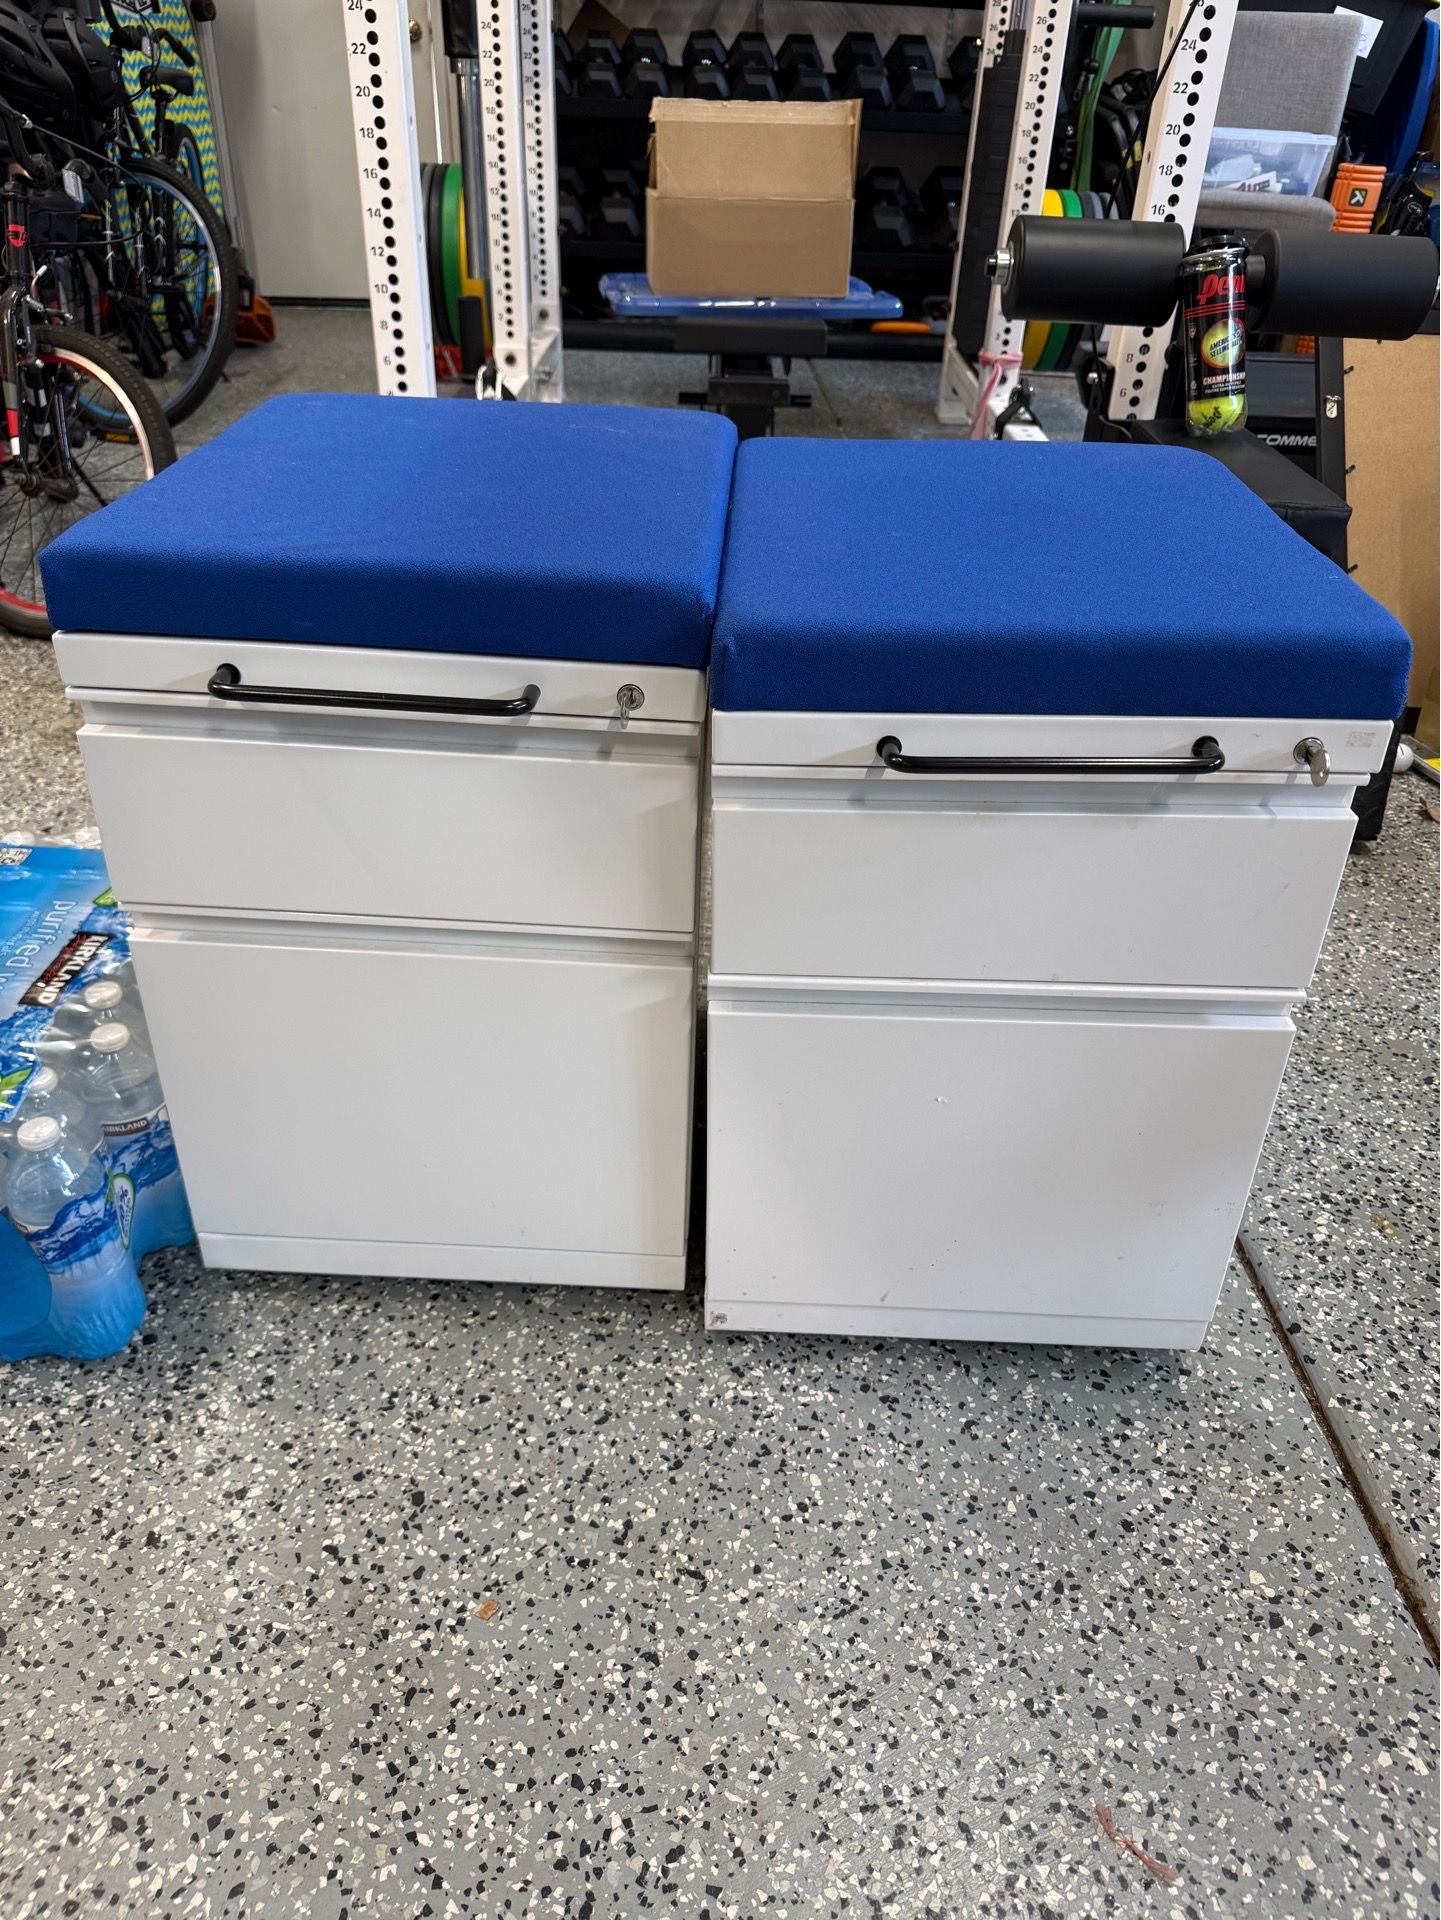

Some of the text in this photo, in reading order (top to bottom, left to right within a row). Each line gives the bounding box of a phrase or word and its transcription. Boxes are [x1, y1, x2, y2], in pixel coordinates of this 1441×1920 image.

[347, 0, 363, 10] 24
[481, 21, 491, 29] 24
[1036, 16, 1047, 25] 26
[351, 42, 367, 54] 22
[1032, 45, 1043, 53] 24
[1181, 39, 1197, 51] 24
[482, 50, 493, 58] 22
[484, 78, 495, 87] 20
[1028, 73, 1040, 82] 22
[355, 85, 371, 97] 20
[1173, 82, 1189, 94] 22
[1024, 102, 1036, 110] 20
[359, 127, 375, 139] 18
[1165, 124, 1181, 135] 20
[1018, 156, 1028, 164] 16
[363, 168, 378, 179] 16
[1158, 164, 1173, 176] 18
[1014, 183, 1024, 191] 14
[366, 207, 382, 218] 14
[1151, 204, 1166, 216] 16
[370, 246, 385, 257] 12
[374, 284, 389, 294] 10
[380, 320, 388, 331] 8
[383, 356, 391, 366] 6
[1127, 353, 1134, 363] 8
[1120, 387, 1127, 397] 6
[4, 900, 78, 969] purified
[37, 934, 110, 1005] KIRKLAND
